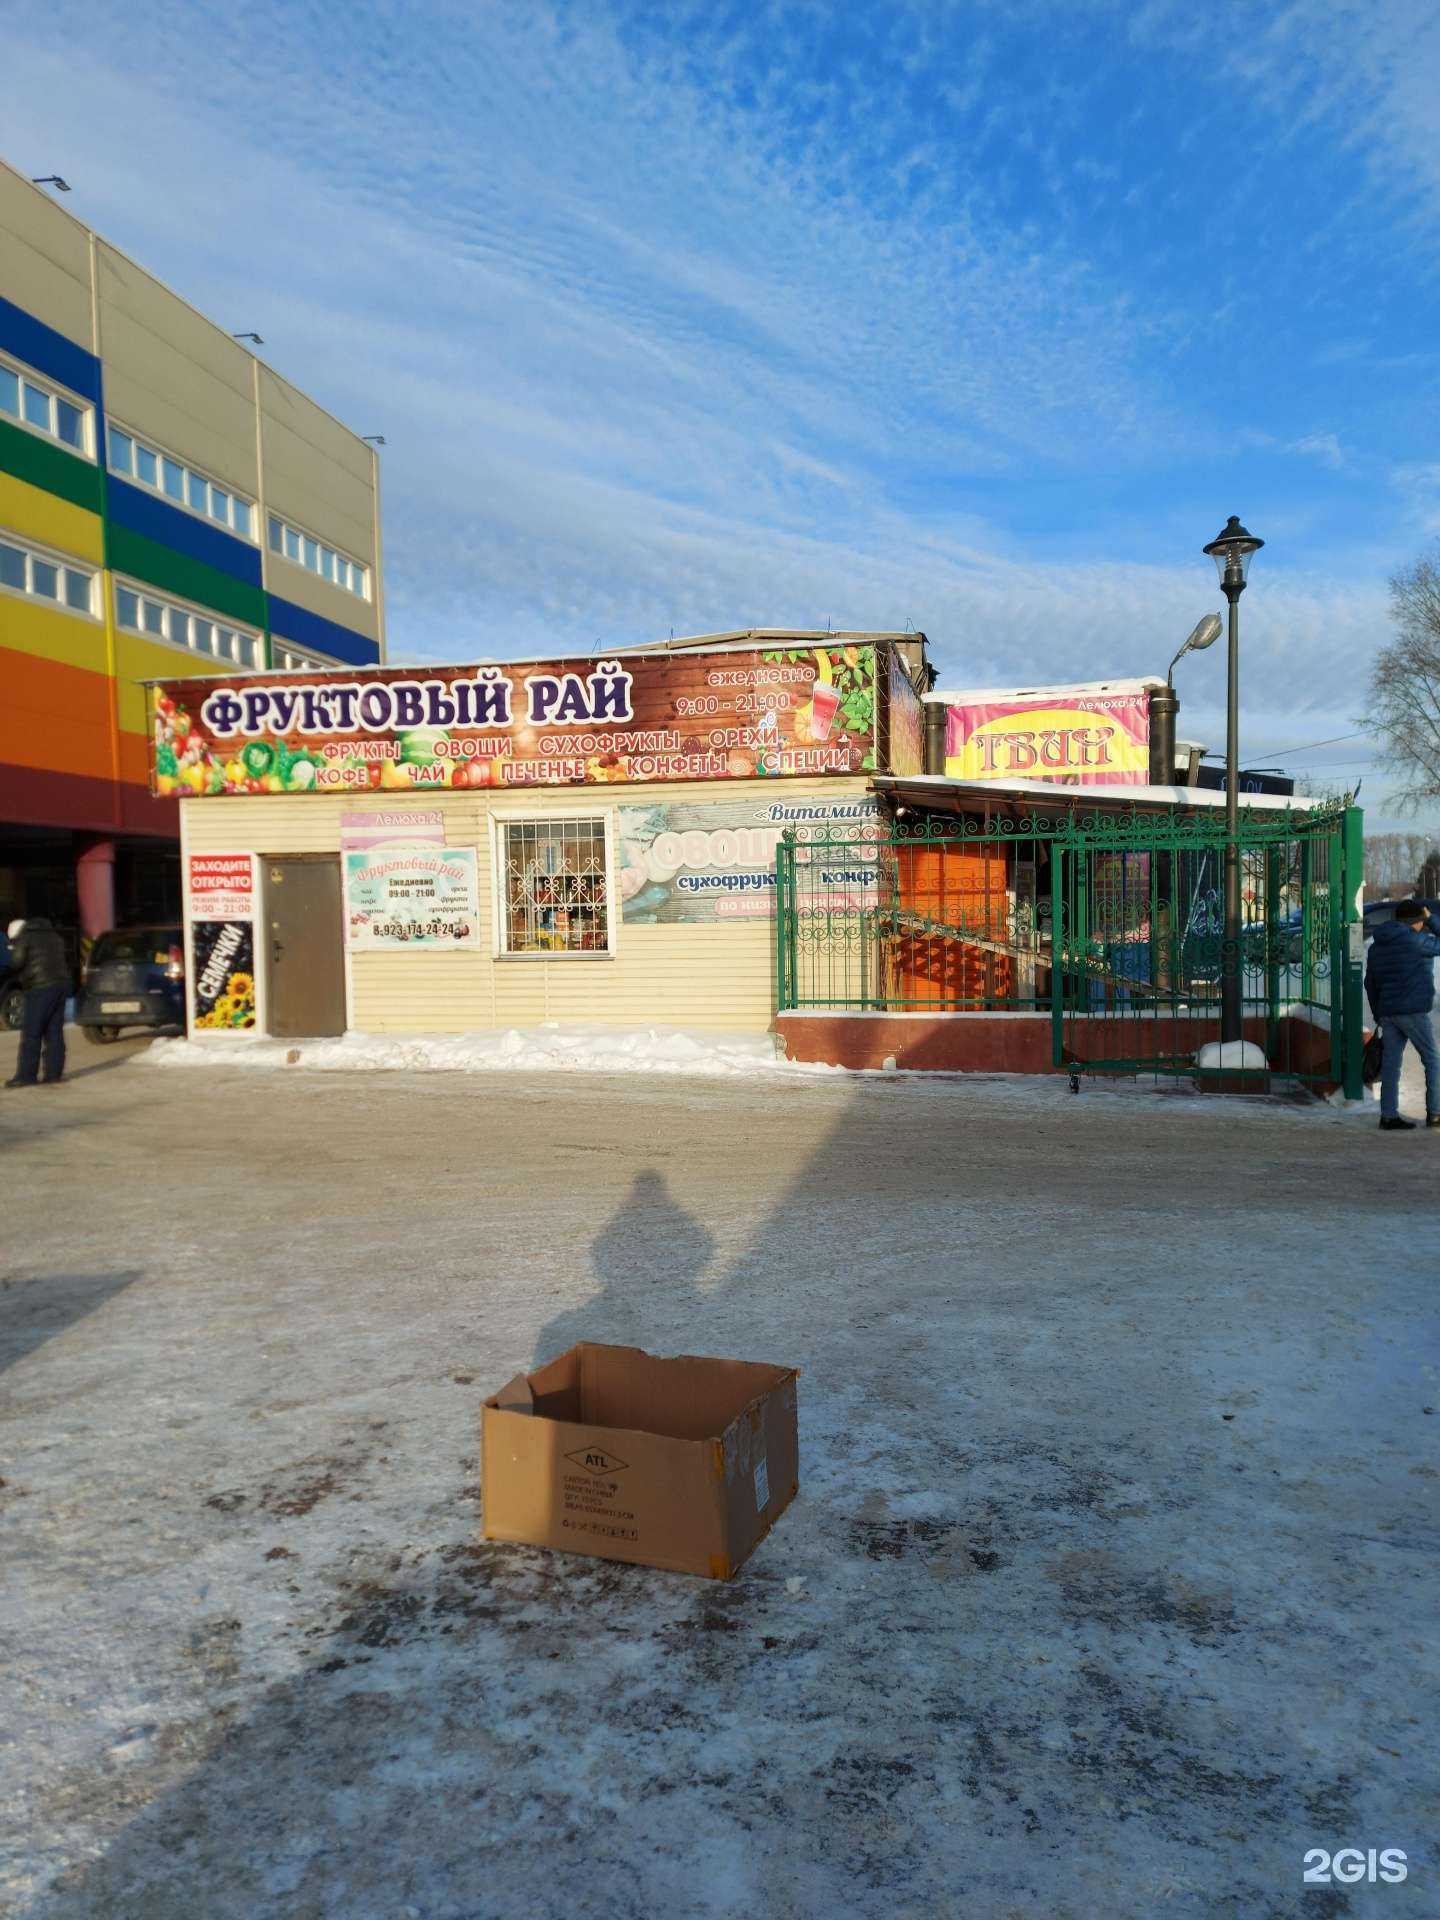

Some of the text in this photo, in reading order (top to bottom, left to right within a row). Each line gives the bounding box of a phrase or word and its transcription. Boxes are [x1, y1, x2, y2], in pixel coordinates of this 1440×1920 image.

[708, 666, 816, 687] ежедневно
[203, 661, 633, 735] ФРУКТОВЫЙ РАЙ
[676, 697, 718, 716] 9:00
[735, 692, 790, 711] 21:00
[322, 727, 778, 760] ФРУКТЫ ОВОЩИ СУХОФРУКТЫ ОРЕХИ
[972, 726, 1114, 771] ТВИН
[315, 748, 850, 785] КОФЕ ЧАЙ ПЕЧЕНЬЕ КОНФЕТЫ СПЕЦИИ
[191, 860, 250, 873] ЗАХОДИТЕ
[356, 856, 465, 881] Фруктовый рай
[192, 876, 252, 889] ОТКРЫТО
[389, 878, 434, 887] Ежедневно
[678, 872, 792, 892] сухофрук
[415, 889, 435, 897] 21:00
[223, 904, 250, 913] 21:00
[197, 923, 244, 998] СЕМЕЧКИ
[585, 1453, 608, 1468] ATL
